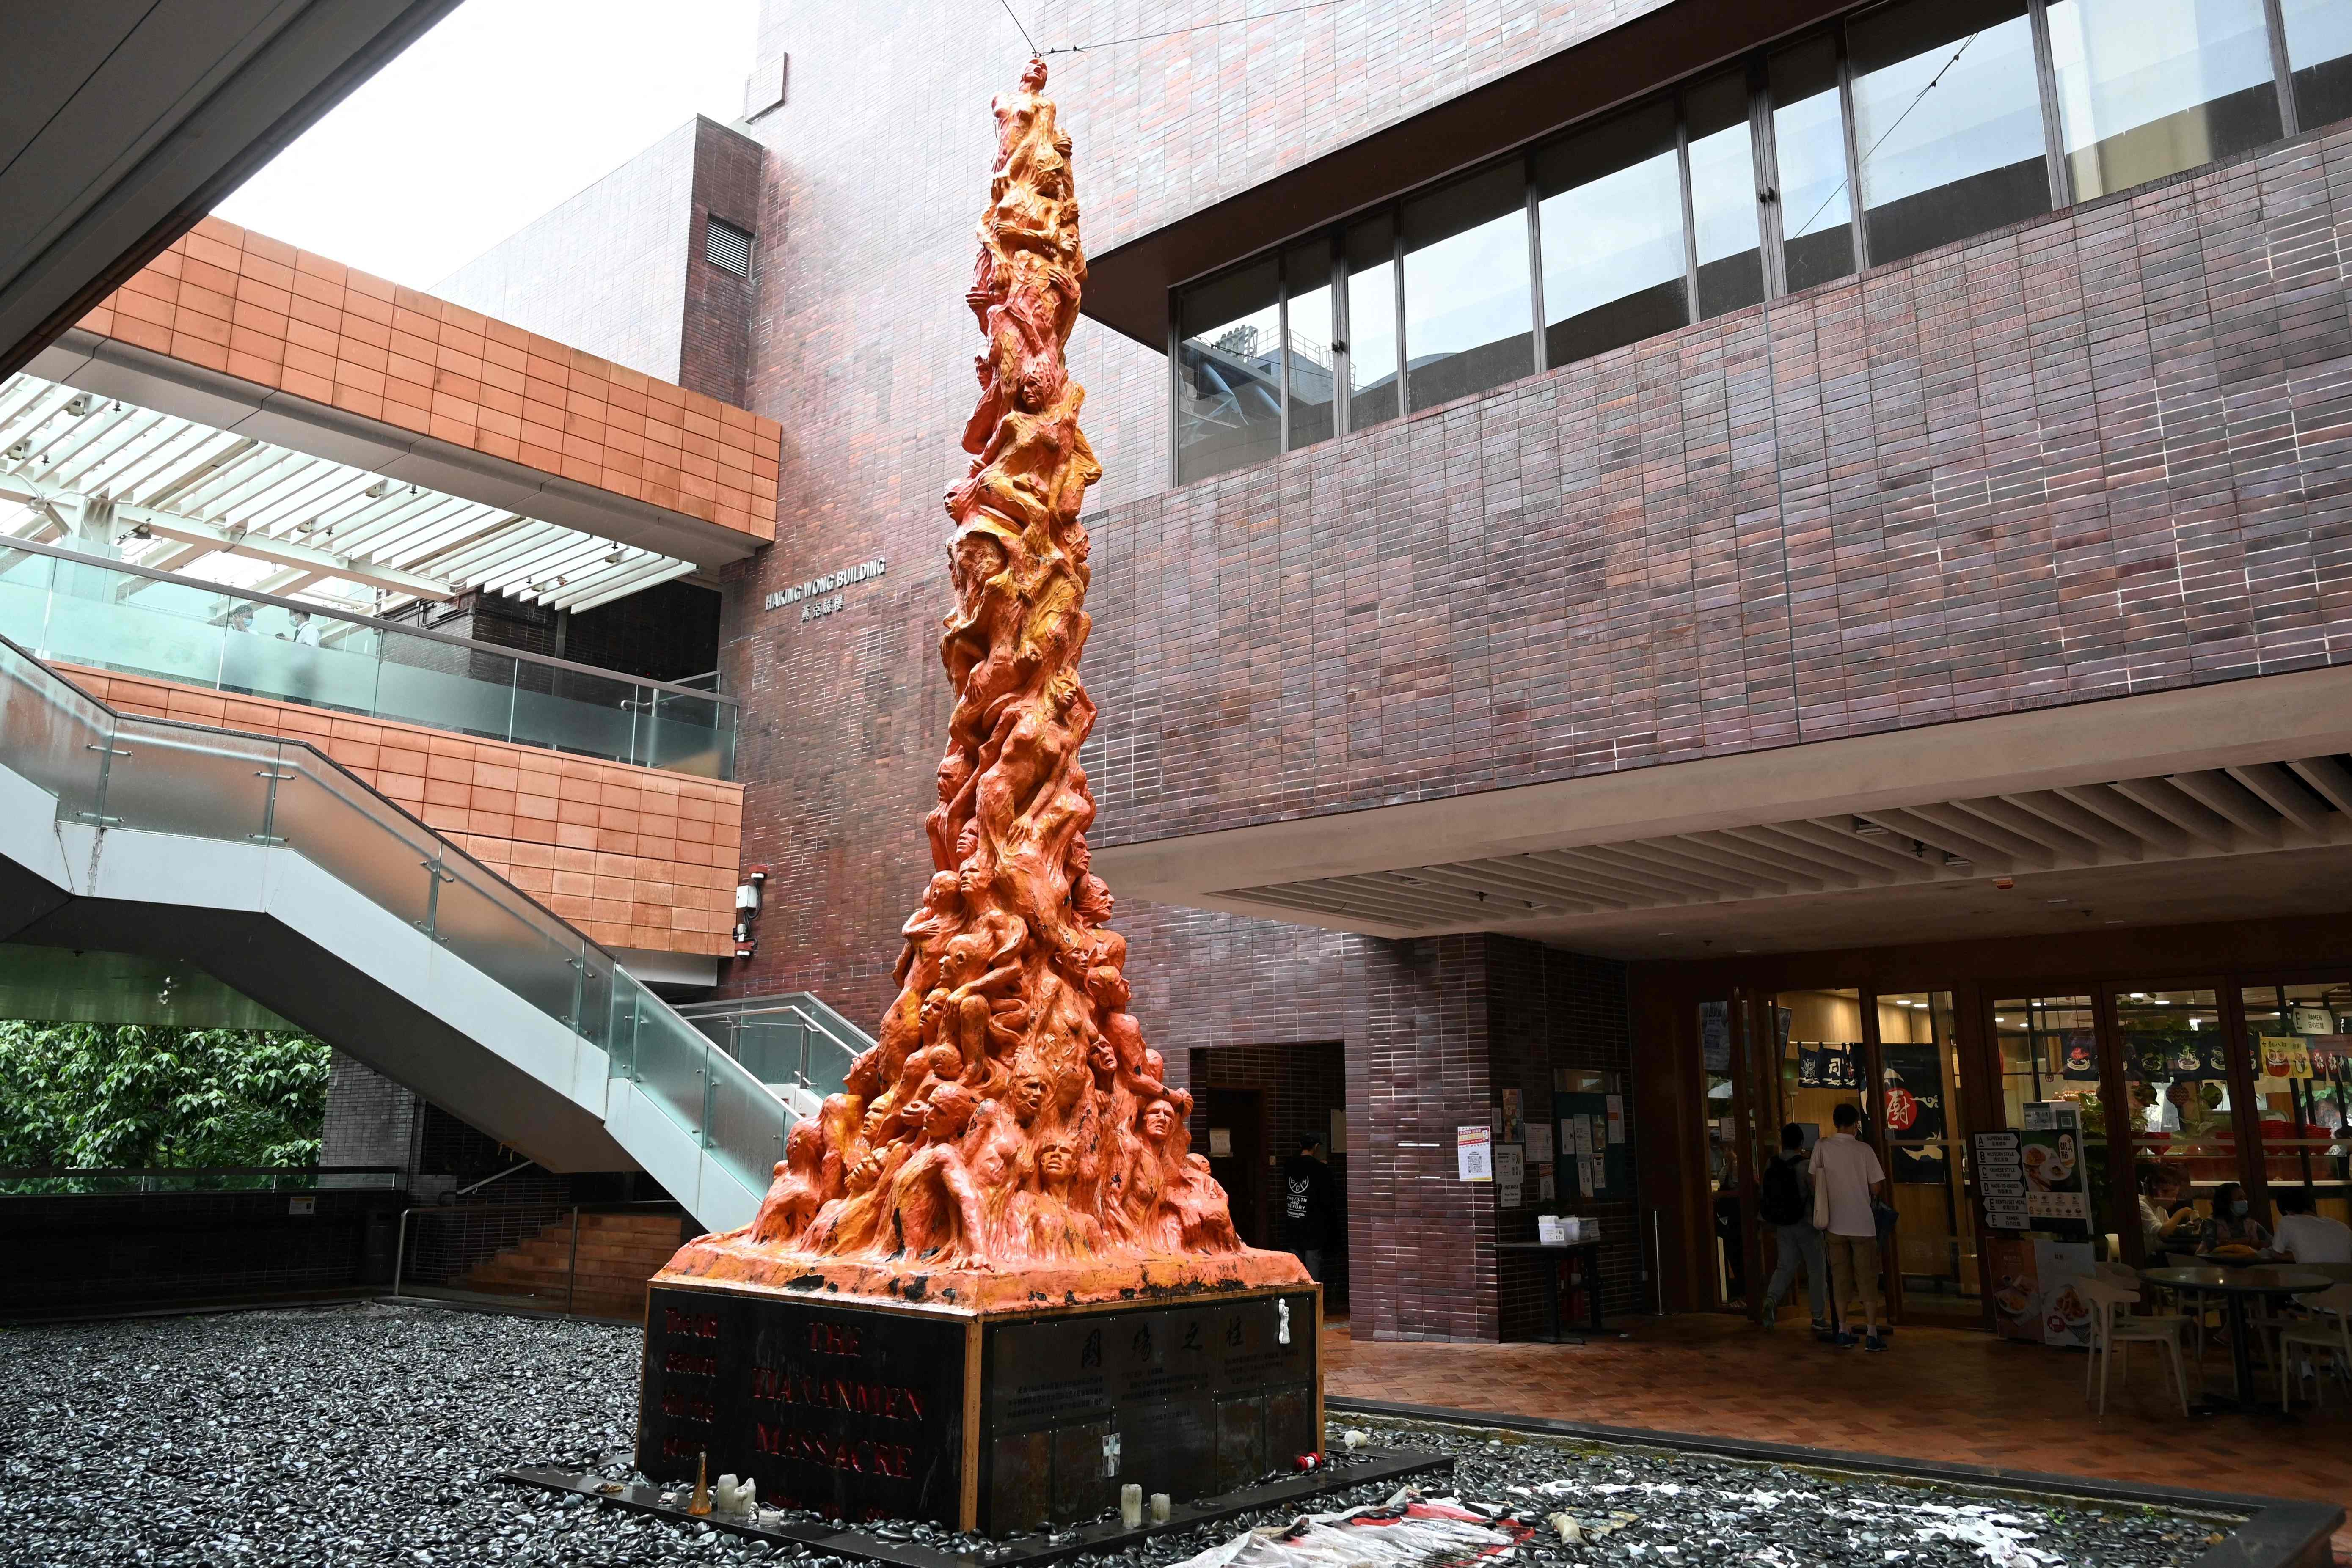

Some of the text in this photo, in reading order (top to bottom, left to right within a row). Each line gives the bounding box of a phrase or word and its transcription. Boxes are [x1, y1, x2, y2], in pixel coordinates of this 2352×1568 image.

[765, 557, 886, 611] HAKING WONG BUILDING
[2295, 1012, 2300, 1025] F
[1979, 1136, 1983, 1145] A
[1980, 1151, 1985, 1160] B
[1982, 1167, 1987, 1176] C
[1984, 1183, 1989, 1191] D
[1990, 1199, 1994, 1208] E
[1991, 1215, 1996, 1223] F
[807, 1321, 863, 1357] THE
[752, 1367, 924, 1421] TIANANMEN
[755, 1422, 914, 1479] MASSACRE
